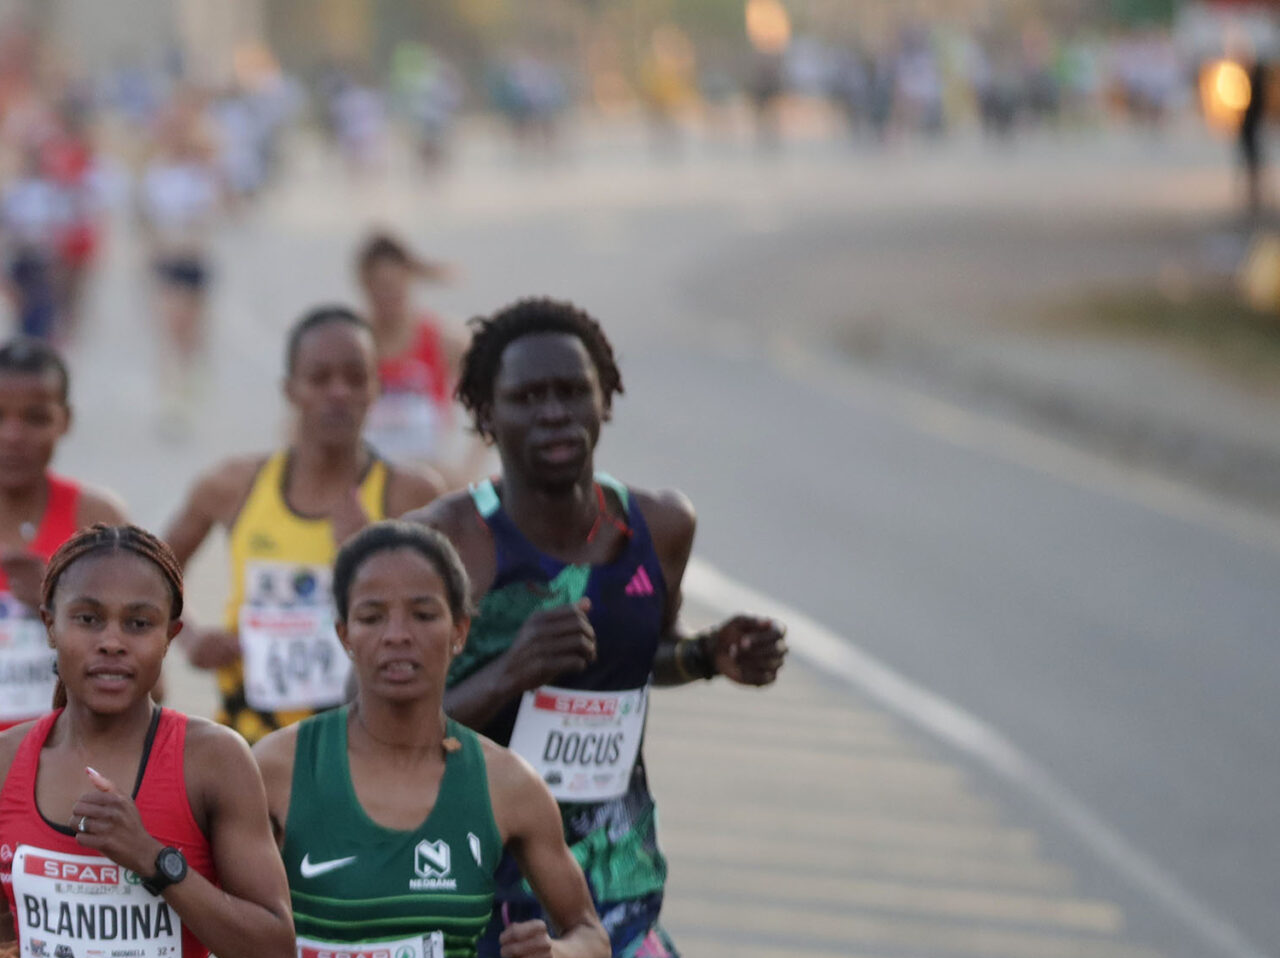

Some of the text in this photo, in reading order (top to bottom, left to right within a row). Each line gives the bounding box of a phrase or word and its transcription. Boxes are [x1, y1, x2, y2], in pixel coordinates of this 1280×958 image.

[543, 729, 623, 766] DOCUS
[44, 860, 118, 882] SPAR
[22, 893, 173, 941] BLANDINA
